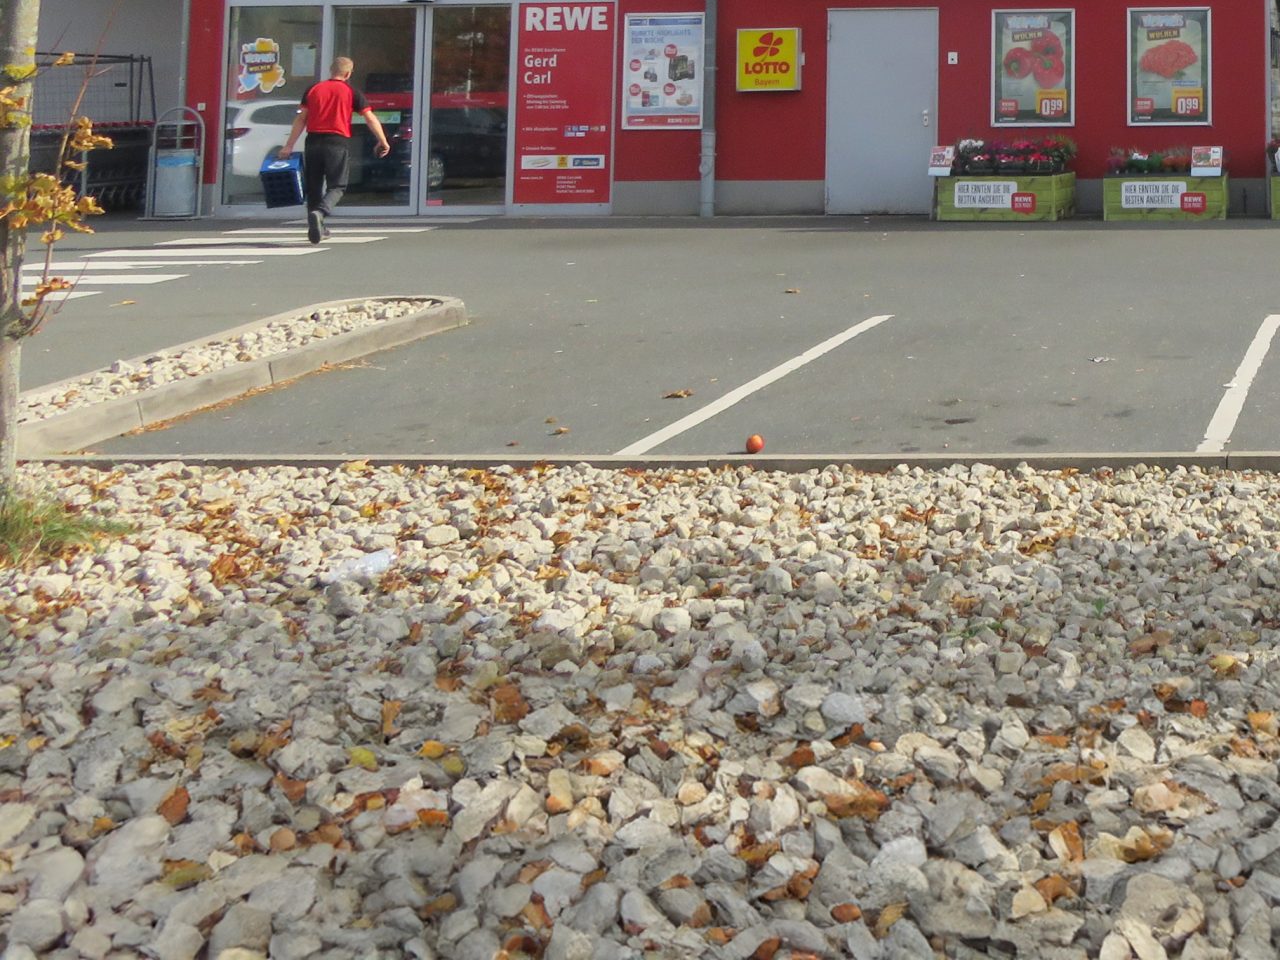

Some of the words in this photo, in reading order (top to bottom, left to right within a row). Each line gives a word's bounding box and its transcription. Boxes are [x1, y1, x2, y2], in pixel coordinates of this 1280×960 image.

[525, 6, 608, 32] REWE
[1014, 31, 1042, 40] WOCHEN
[1149, 30, 1178, 39] WOCHEN
[524, 54, 557, 67] Gerd
[744, 61, 790, 75] LOTTO
[524, 71, 551, 84] Carl
[754, 79, 780, 87] Bayern
[958, 184, 969, 193] HIER
[971, 184, 992, 193] ERNTEN
[993, 184, 1001, 193] SIE
[1125, 184, 1136, 193] HIER
[1139, 184, 1159, 193] ERNTEN
[1161, 184, 1169, 193] SIE
[1172, 184, 1180, 193] DIE
[958, 195, 976, 204] BESTEN
[1125, 195, 1144, 204] BESTEN
